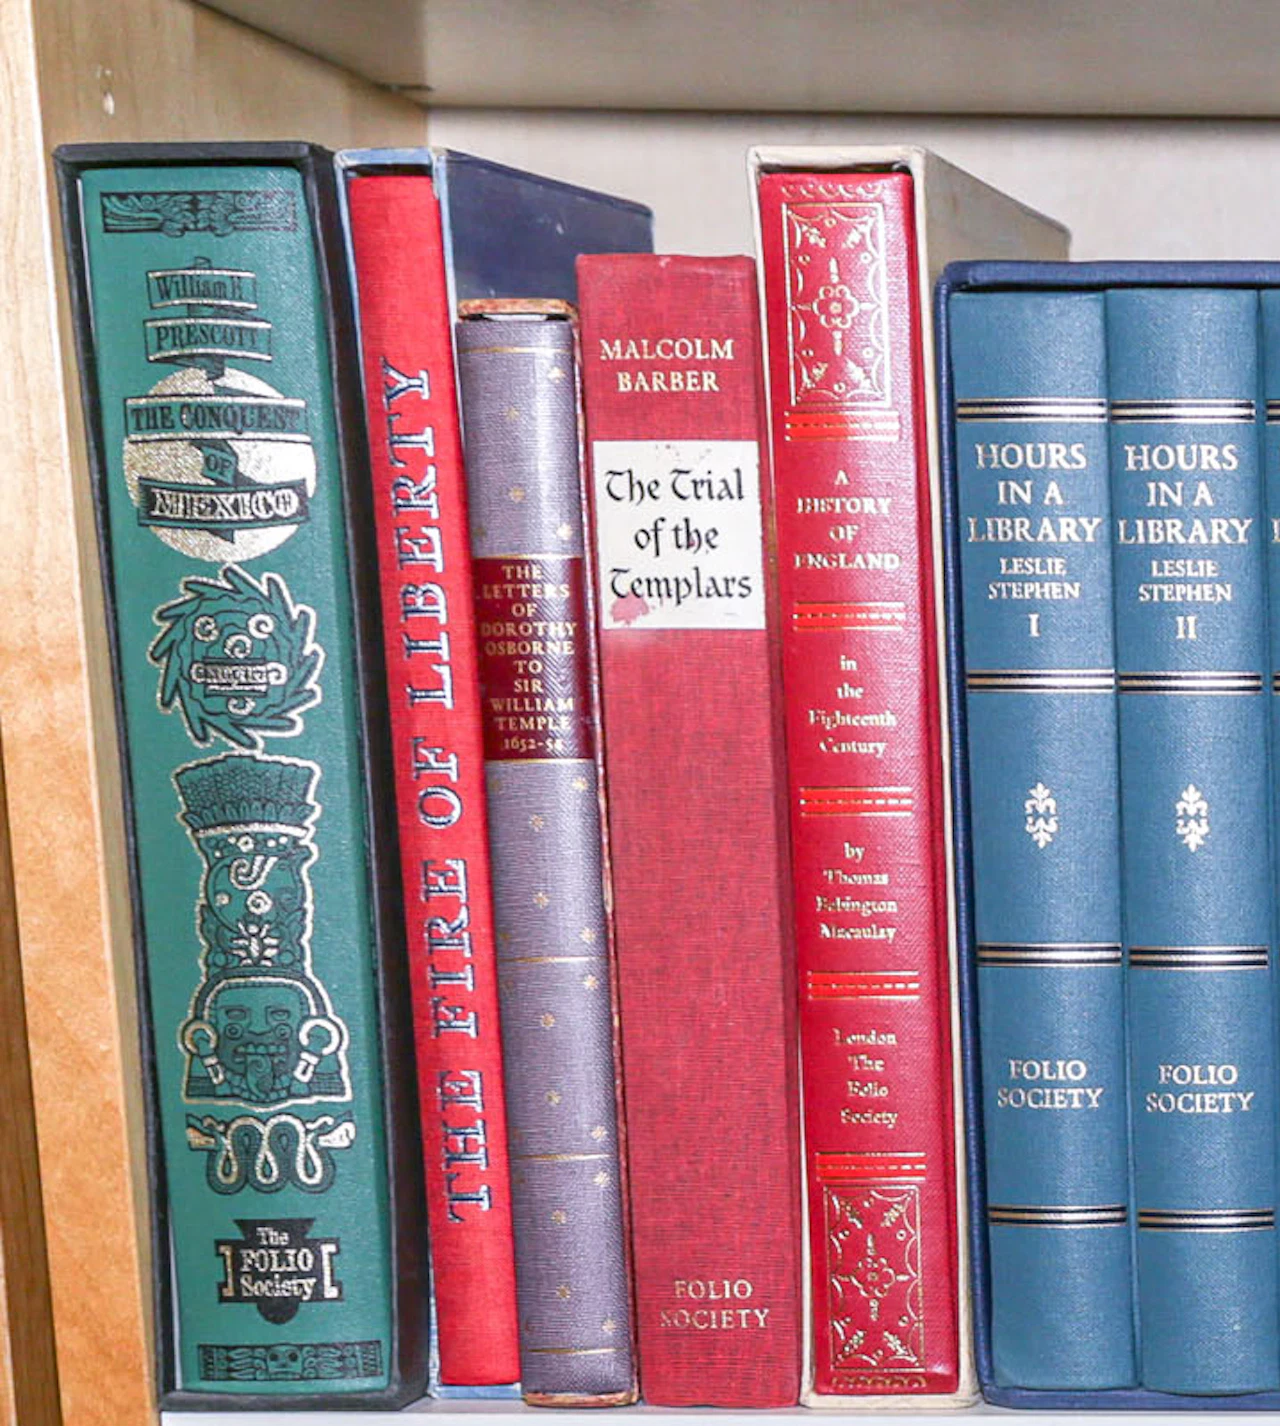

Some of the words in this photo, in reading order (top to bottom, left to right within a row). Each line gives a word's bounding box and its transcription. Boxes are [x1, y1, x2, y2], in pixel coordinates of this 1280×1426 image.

[156, 326, 258, 351] PRESCOTT
[600, 338, 735, 361] MALCOLM
[616, 371, 720, 392] BARBER
[132, 406, 174, 430] THE
[205, 453, 231, 476] OF
[975, 443, 1088, 470] HOURS
[1124, 443, 1239, 472] HOURS
[605, 469, 661, 508] The
[671, 469, 746, 501] Trial
[997, 480, 1032, 505] IN
[1044, 482, 1064, 505] A
[1146, 482, 1183, 507] IN
[1194, 483, 1214, 506] A
[383, 359, 453, 709] LIBERTY
[633, 518, 667, 557] of
[672, 518, 719, 555] the
[967, 517, 1101, 543] LIBRARY
[1118, 519, 1253, 545] LIBRARY
[610, 567, 753, 606] Templars
[410, 736, 463, 831] OF
[421, 858, 479, 1039] FIRE
[1007, 1060, 1087, 1081] FOLIO
[997, 1087, 1104, 1110] SOCIETY
[437, 1068, 494, 1225] THE
[257, 1227, 290, 1247] The
[239, 1247, 314, 1273] FOLIO
[239, 1275, 316, 1301] Society
[674, 1279, 754, 1300] FOLIO
